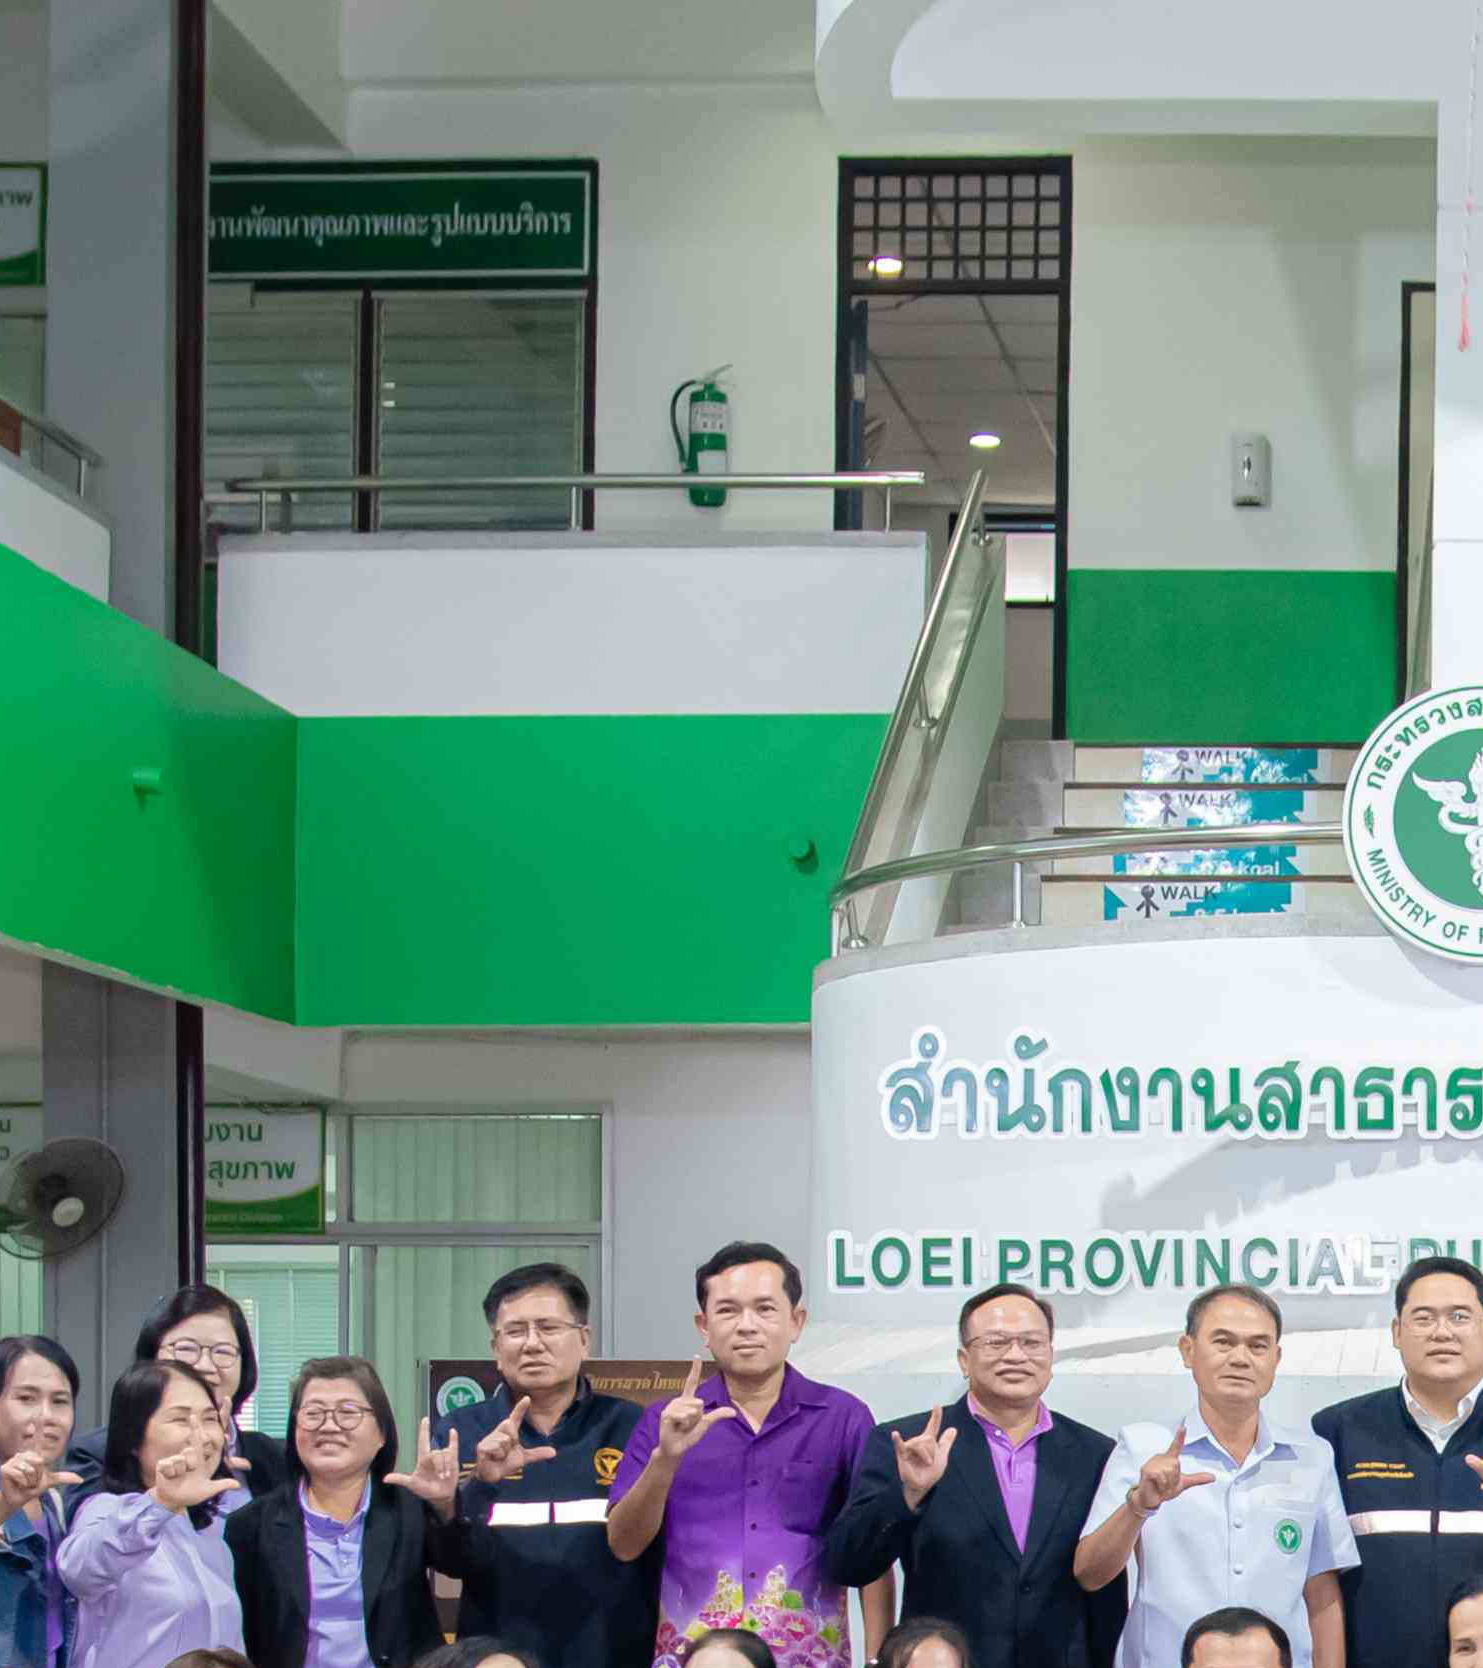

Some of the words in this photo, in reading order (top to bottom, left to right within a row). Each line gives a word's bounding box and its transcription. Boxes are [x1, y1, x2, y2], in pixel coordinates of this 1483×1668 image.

[1194, 750, 1249, 764] WALK
[1178, 792, 1235, 808] WALK
[1160, 885, 1218, 901] WALK
[1367, 848, 1438, 929] MINISTRY
[1442, 920, 1470, 942] OF
[836, 1236, 973, 1287] LOEI
[998, 1236, 1383, 1288] PROVINCIAL
